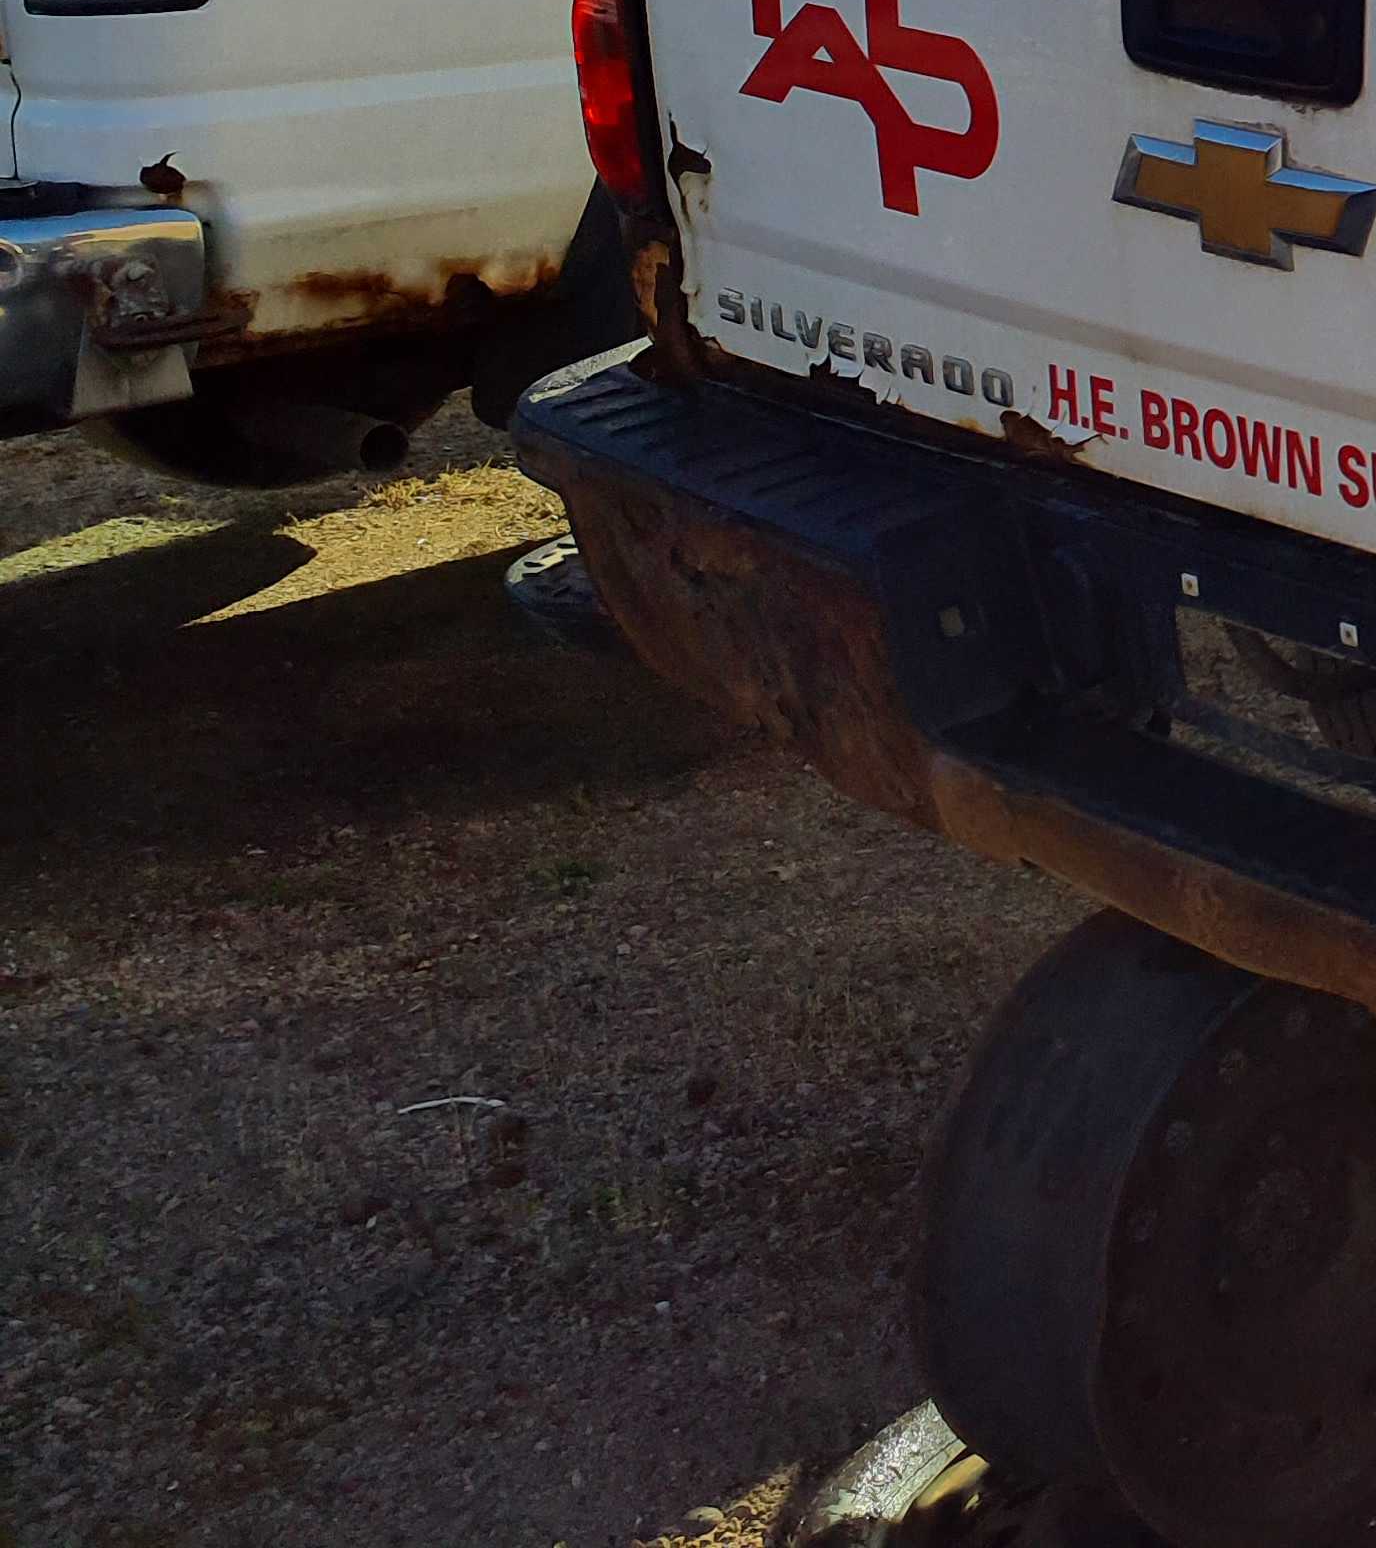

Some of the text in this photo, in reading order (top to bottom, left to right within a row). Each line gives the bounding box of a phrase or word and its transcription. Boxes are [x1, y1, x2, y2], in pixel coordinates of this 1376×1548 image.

[716, 286, 1015, 408] SILVERADO
[1048, 363, 1130, 439] H.E.
[1141, 388, 1322, 497] BROWN
